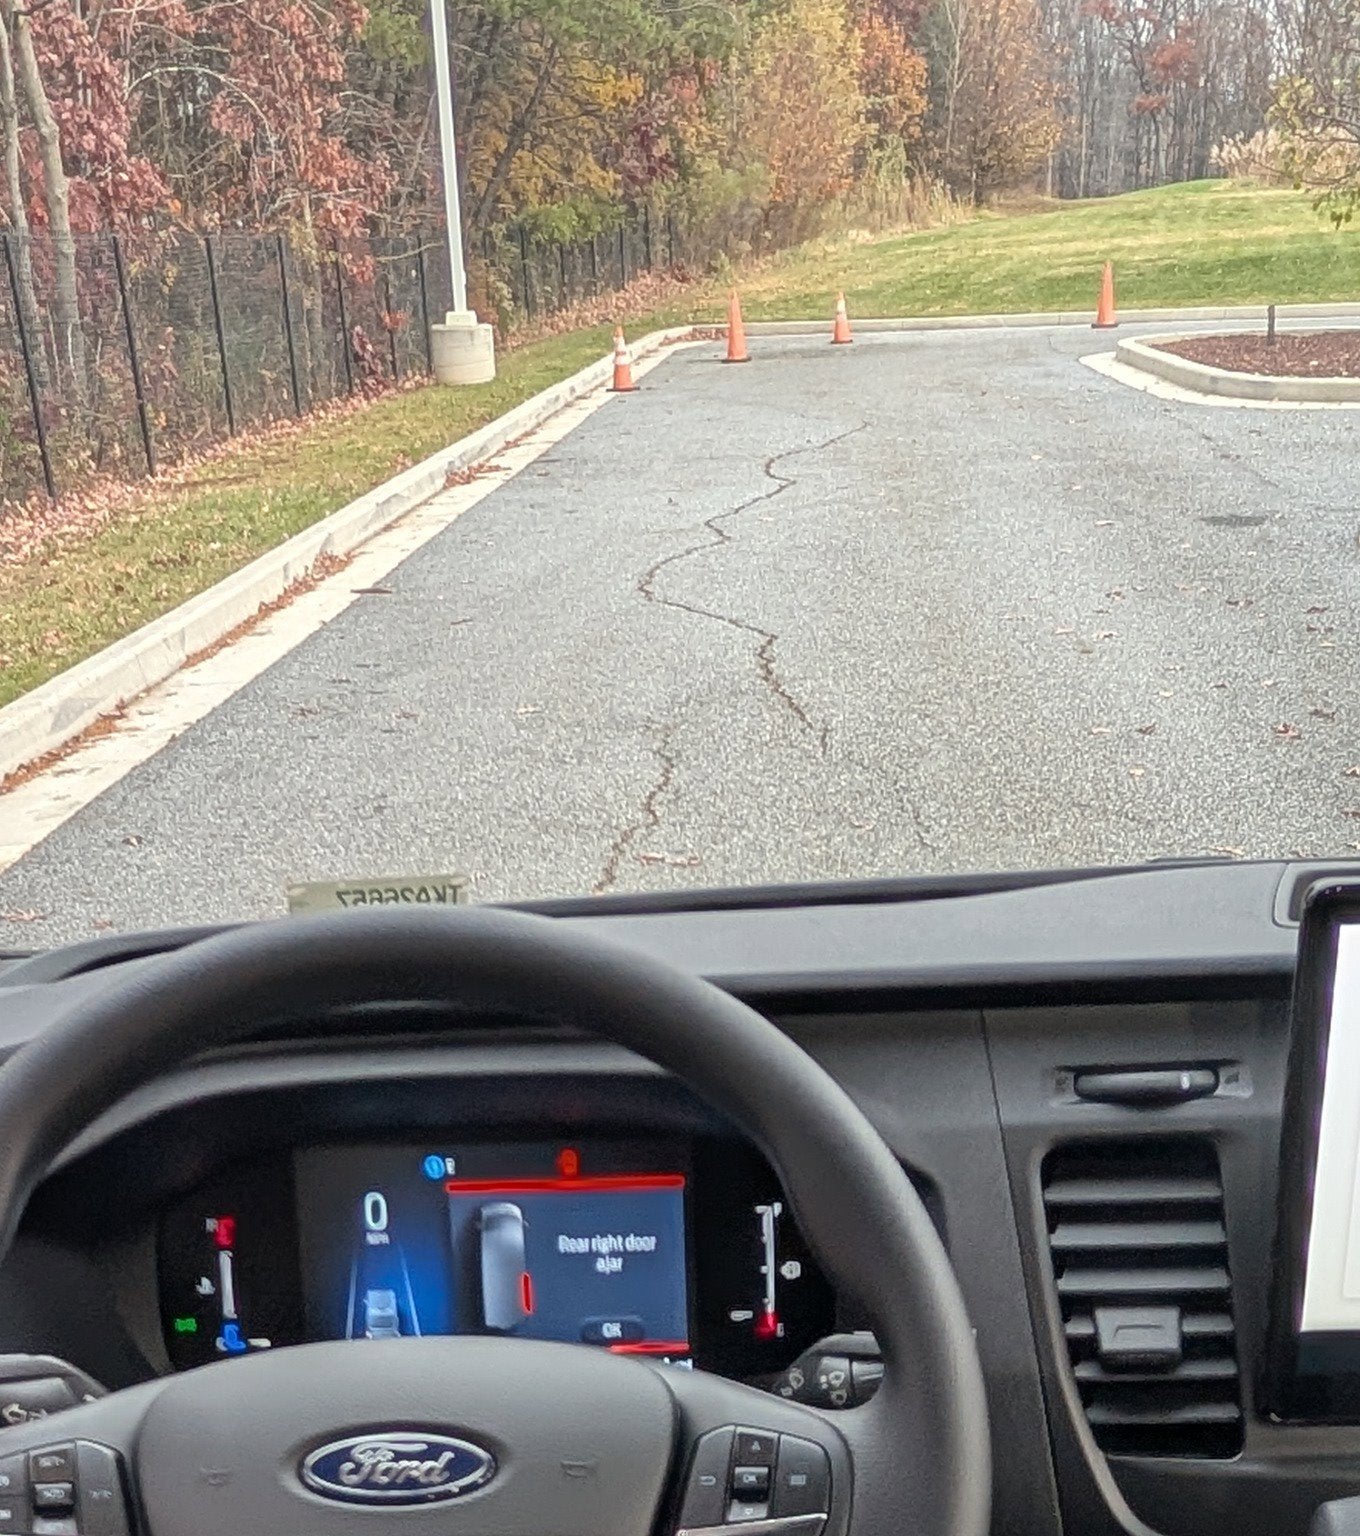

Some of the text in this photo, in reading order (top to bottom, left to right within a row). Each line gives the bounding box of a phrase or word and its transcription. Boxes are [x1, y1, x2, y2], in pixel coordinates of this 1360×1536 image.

[364, 1191, 388, 1231] 0
[558, 1232, 658, 1255] Rear right door
[595, 1254, 623, 1275] ajar
[339, 1441, 455, 1486] Ford
